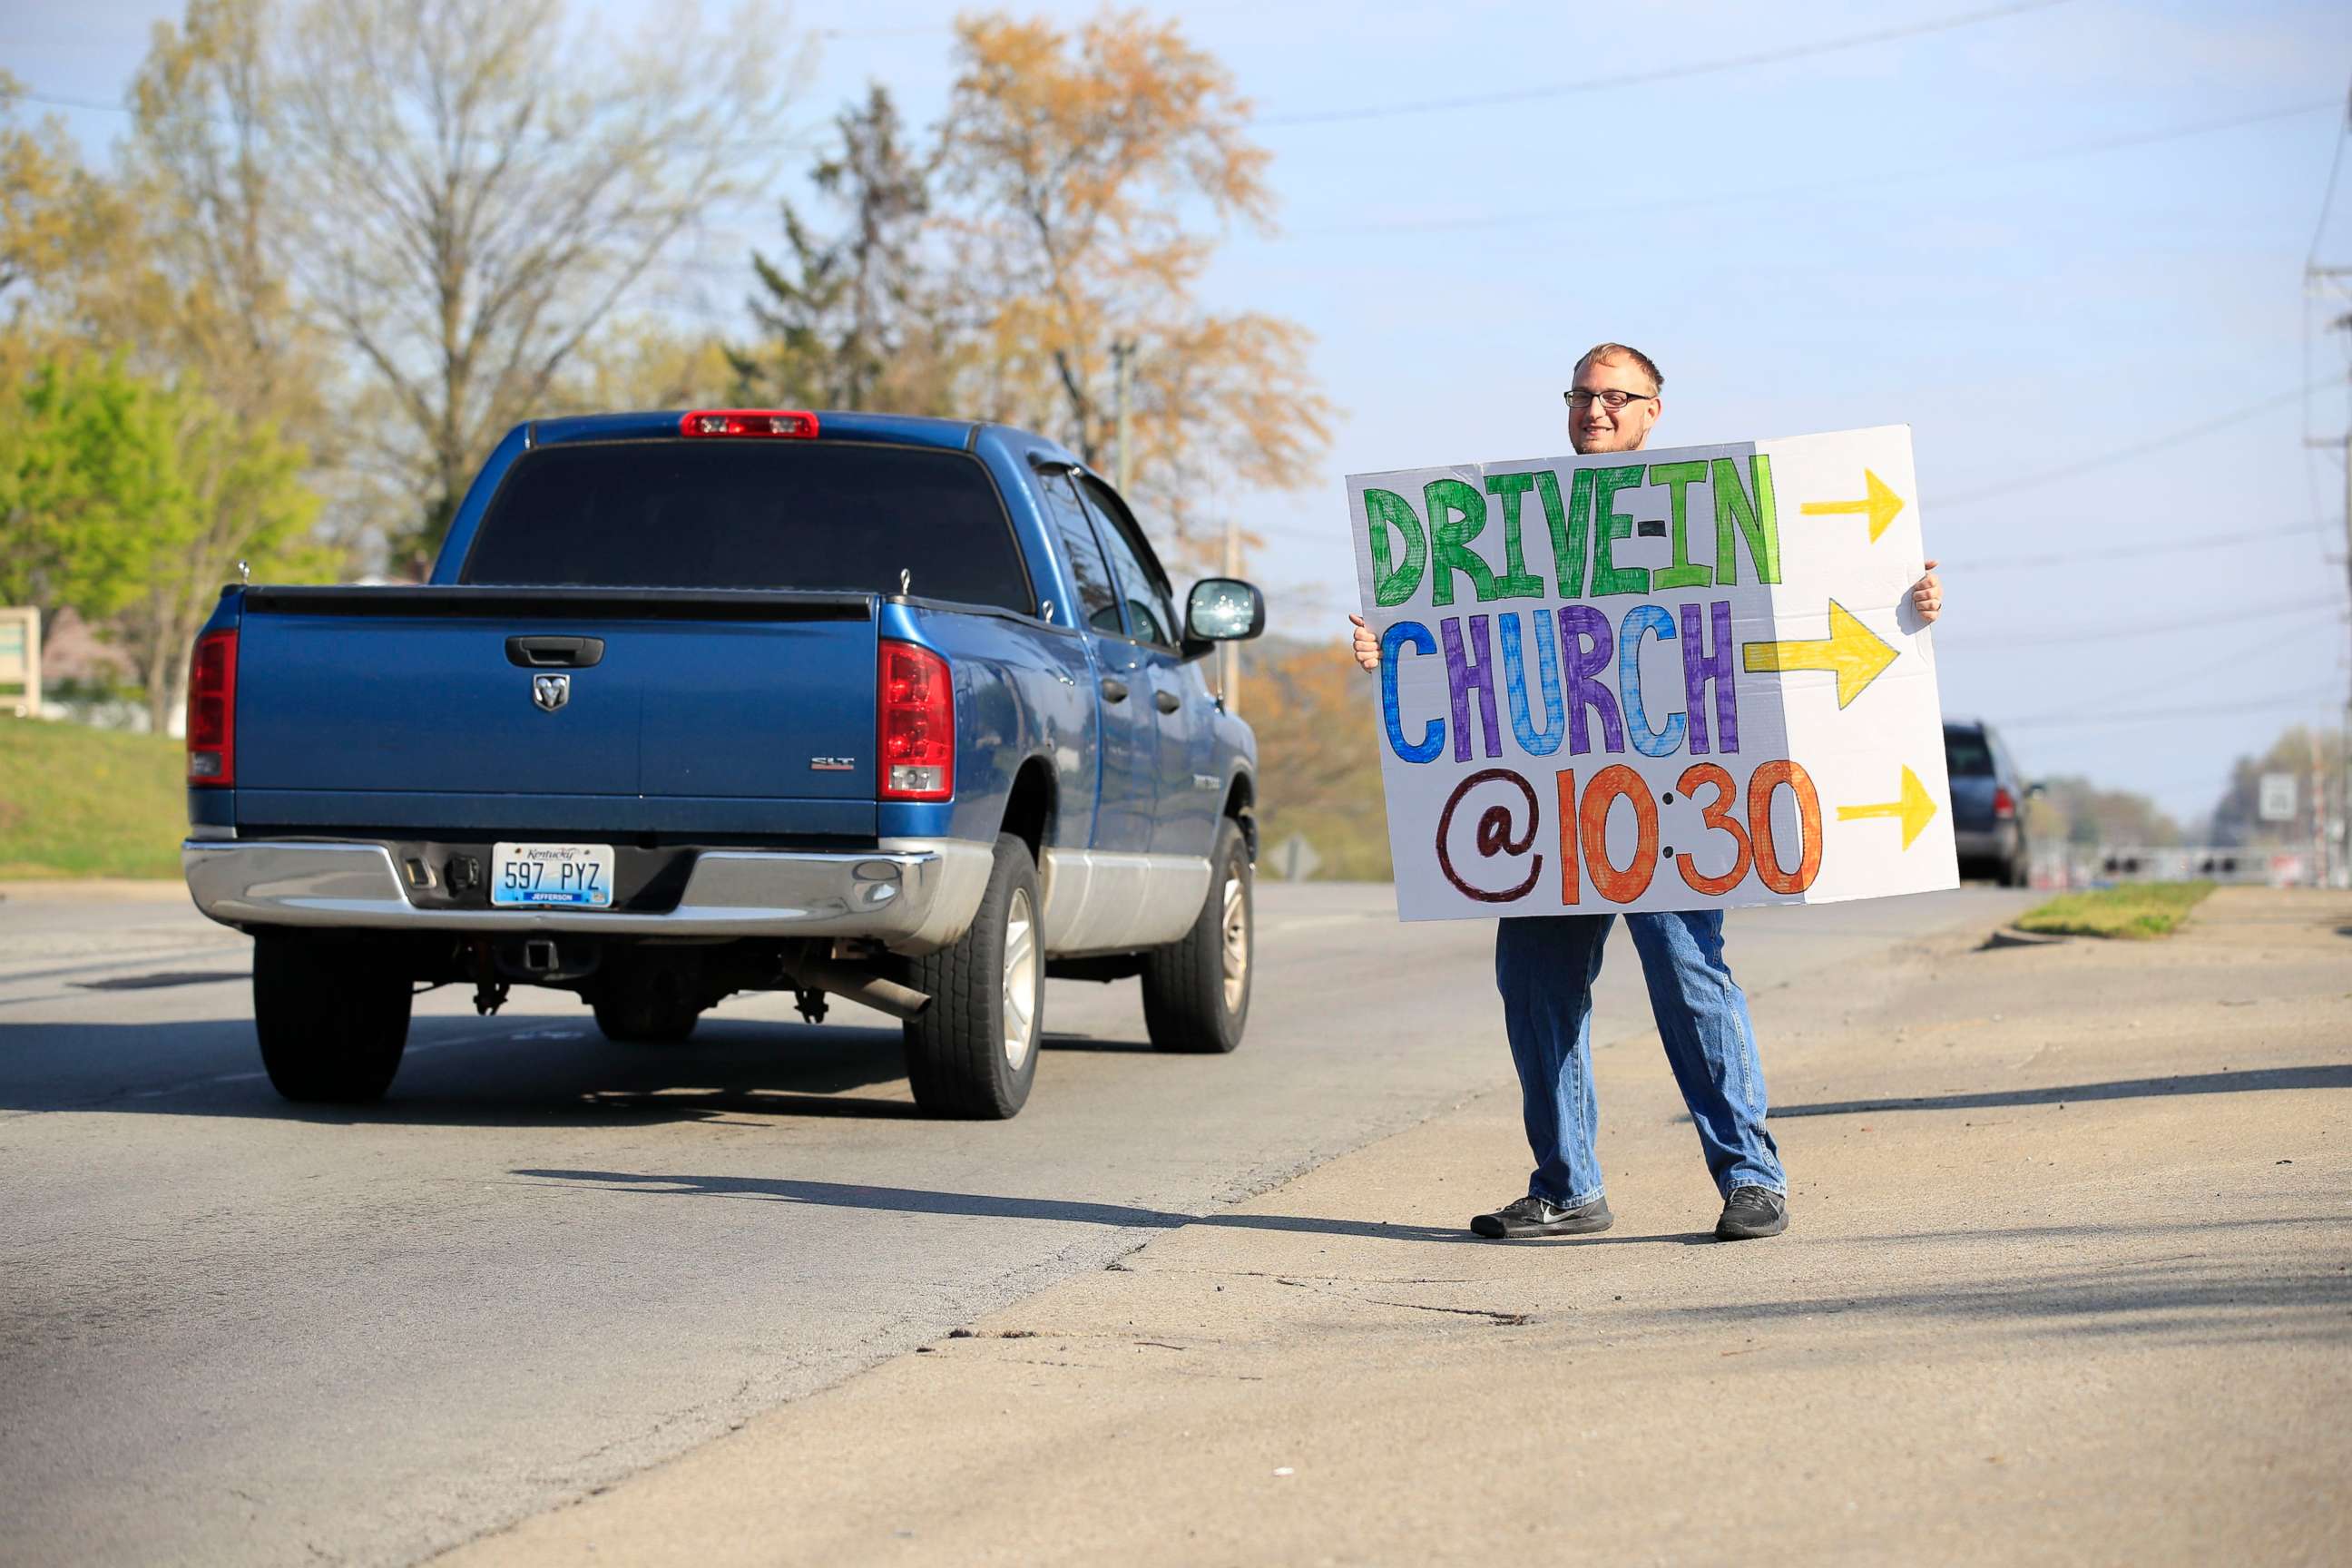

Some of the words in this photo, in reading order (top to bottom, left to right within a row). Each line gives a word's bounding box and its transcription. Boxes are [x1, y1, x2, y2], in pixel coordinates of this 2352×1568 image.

[1364, 454, 1781, 607] DRIVE-IN
[1380, 601, 1740, 763] CHURCH
[811, 757, 855, 769] SLT
[526, 848, 574, 860] Kentucky
[505, 862, 544, 889] 597
[562, 863, 601, 890] PYZ
